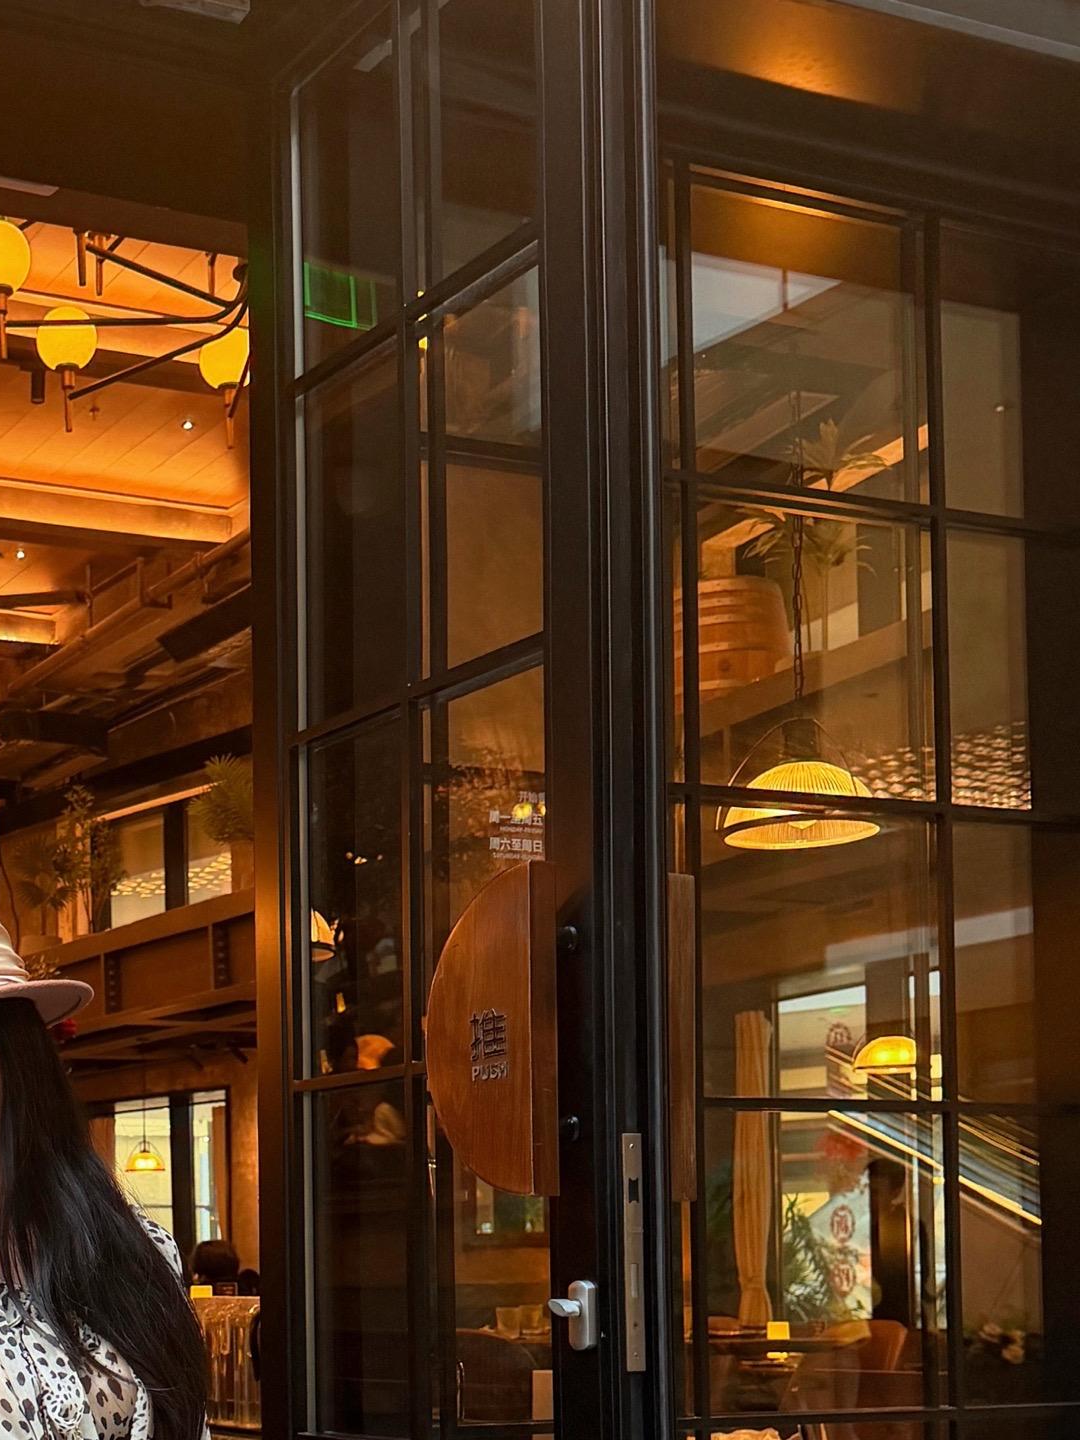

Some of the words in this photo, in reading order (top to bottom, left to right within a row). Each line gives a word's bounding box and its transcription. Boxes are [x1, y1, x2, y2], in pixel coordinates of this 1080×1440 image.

[489, 837, 543, 853] 周六至周日
[470, 1010, 506, 1061] 推
[471, 1063, 508, 1081] PUSH
